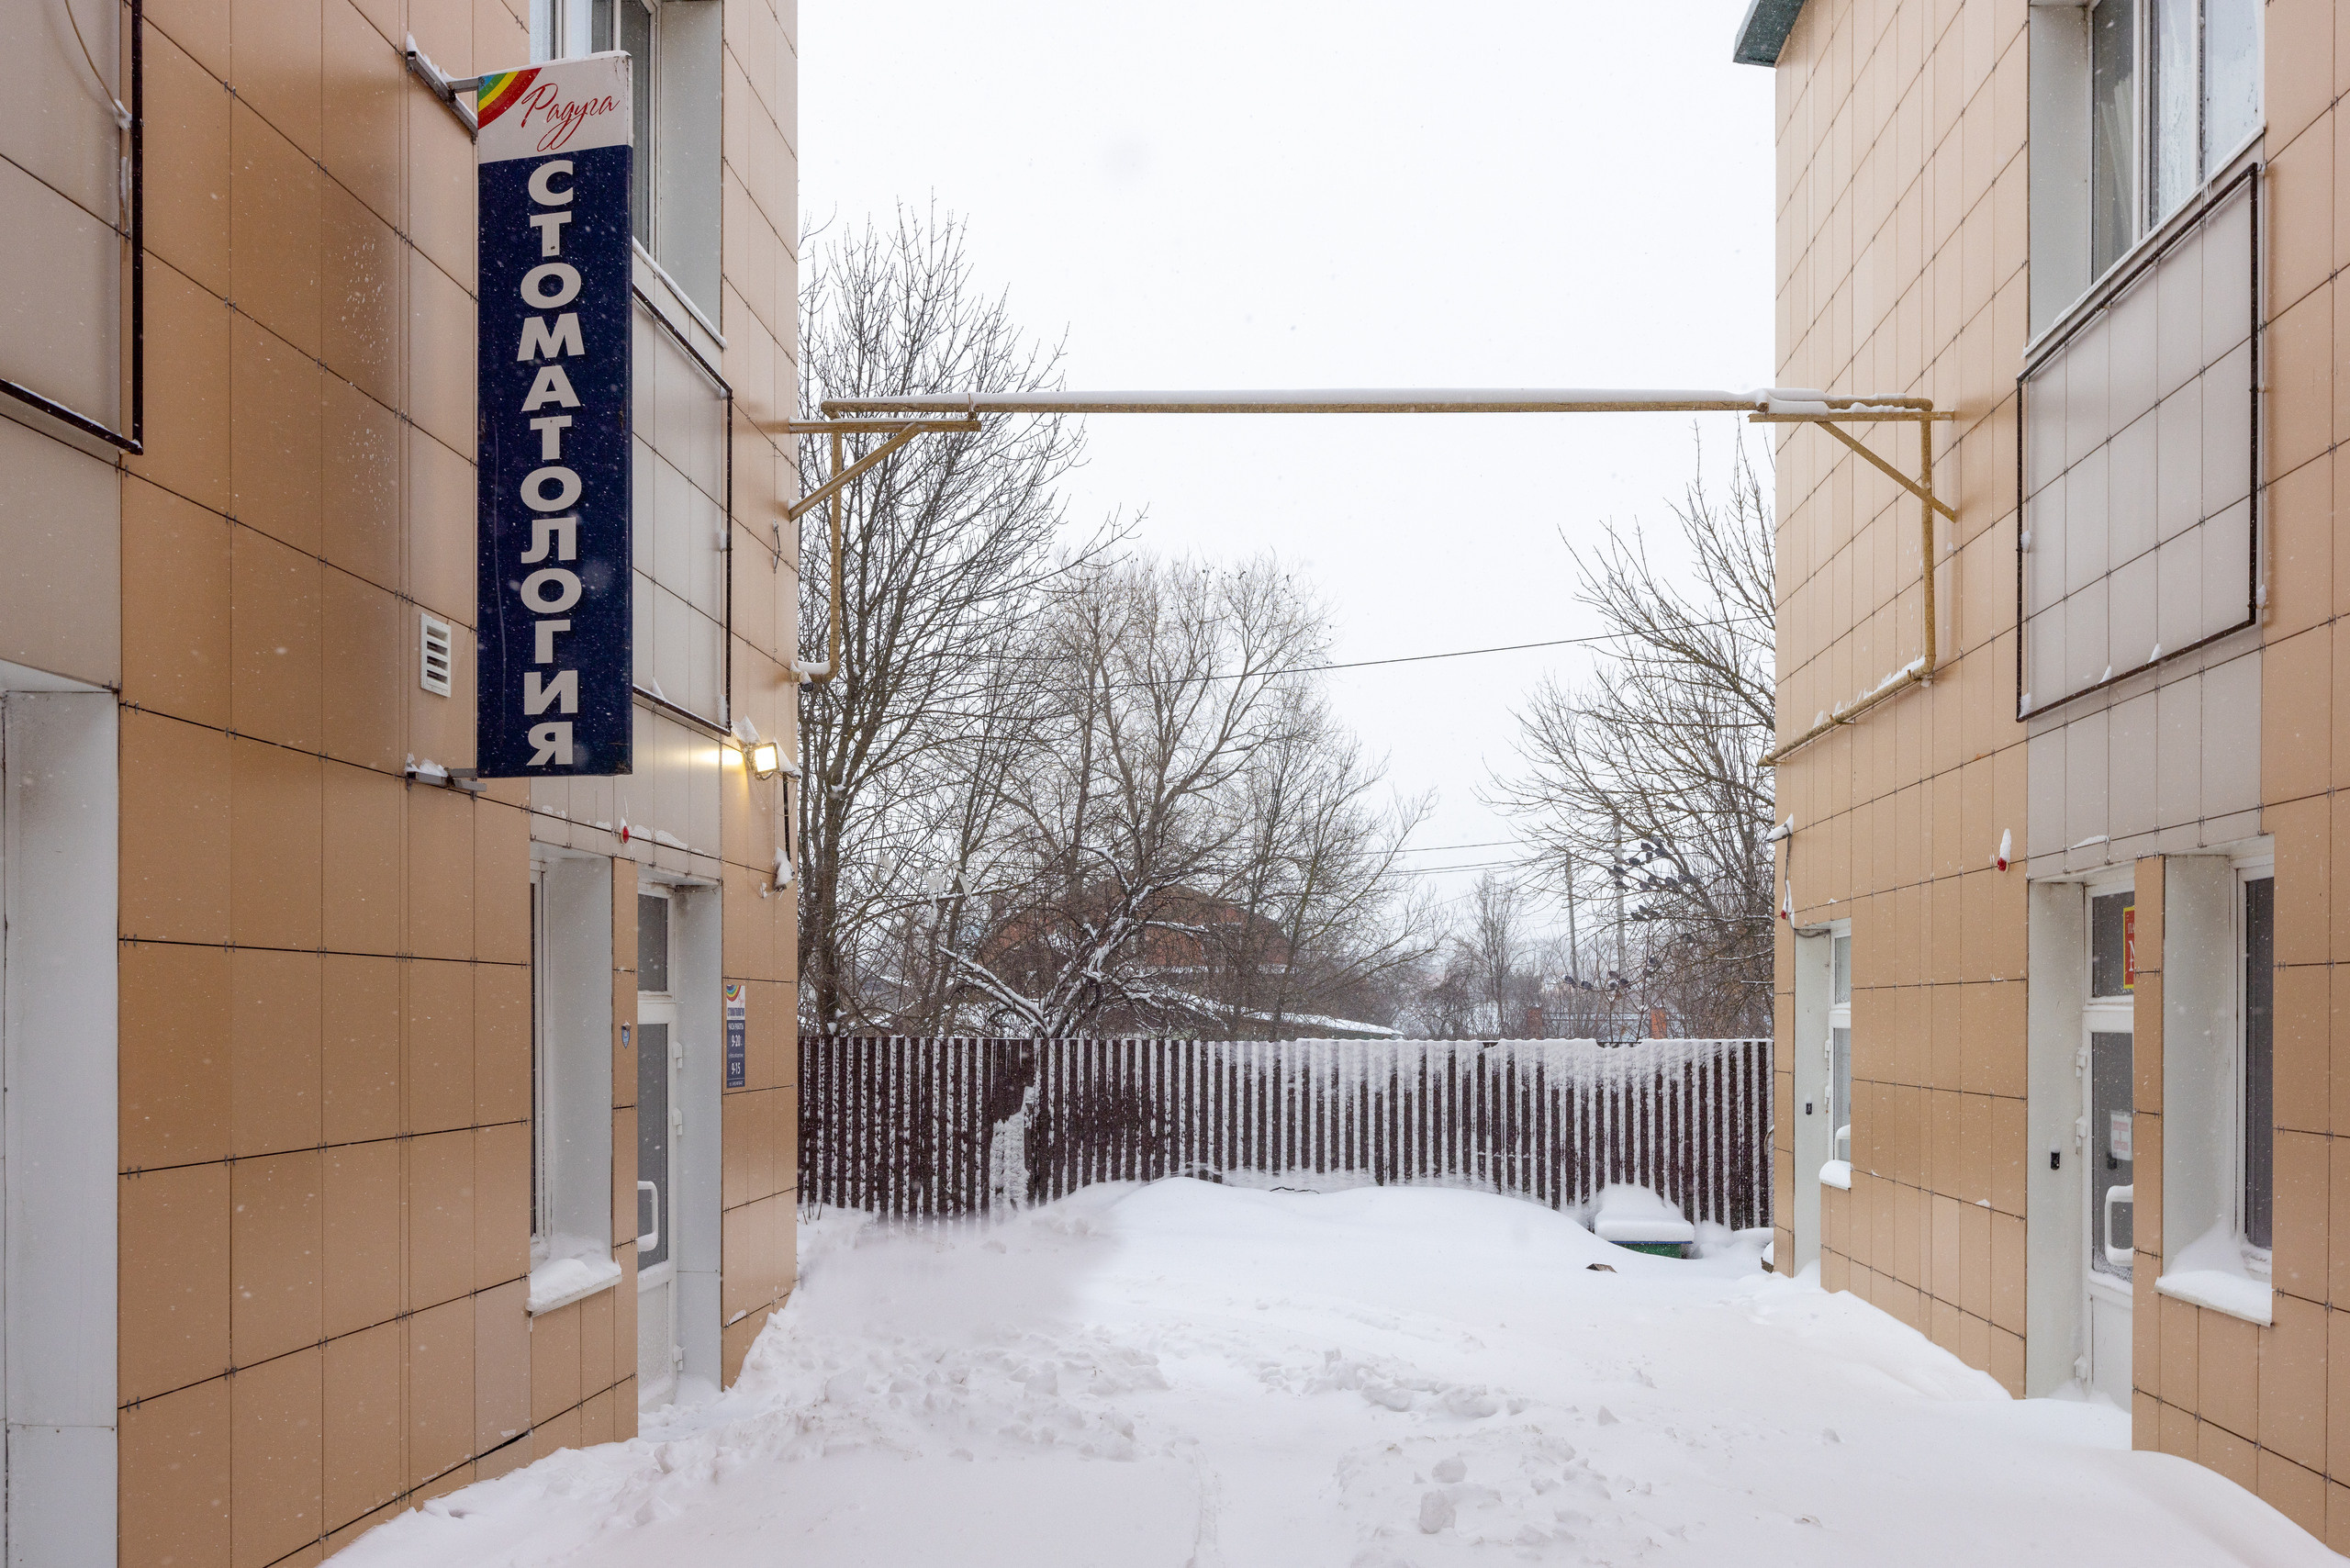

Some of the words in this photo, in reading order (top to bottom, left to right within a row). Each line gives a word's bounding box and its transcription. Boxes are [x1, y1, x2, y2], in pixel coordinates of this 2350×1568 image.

[520, 83, 621, 152] Радуга
[516, 158, 586, 767] СТОМАТОЛОГИЯ
[731, 1062, 741, 1075] 9-15
